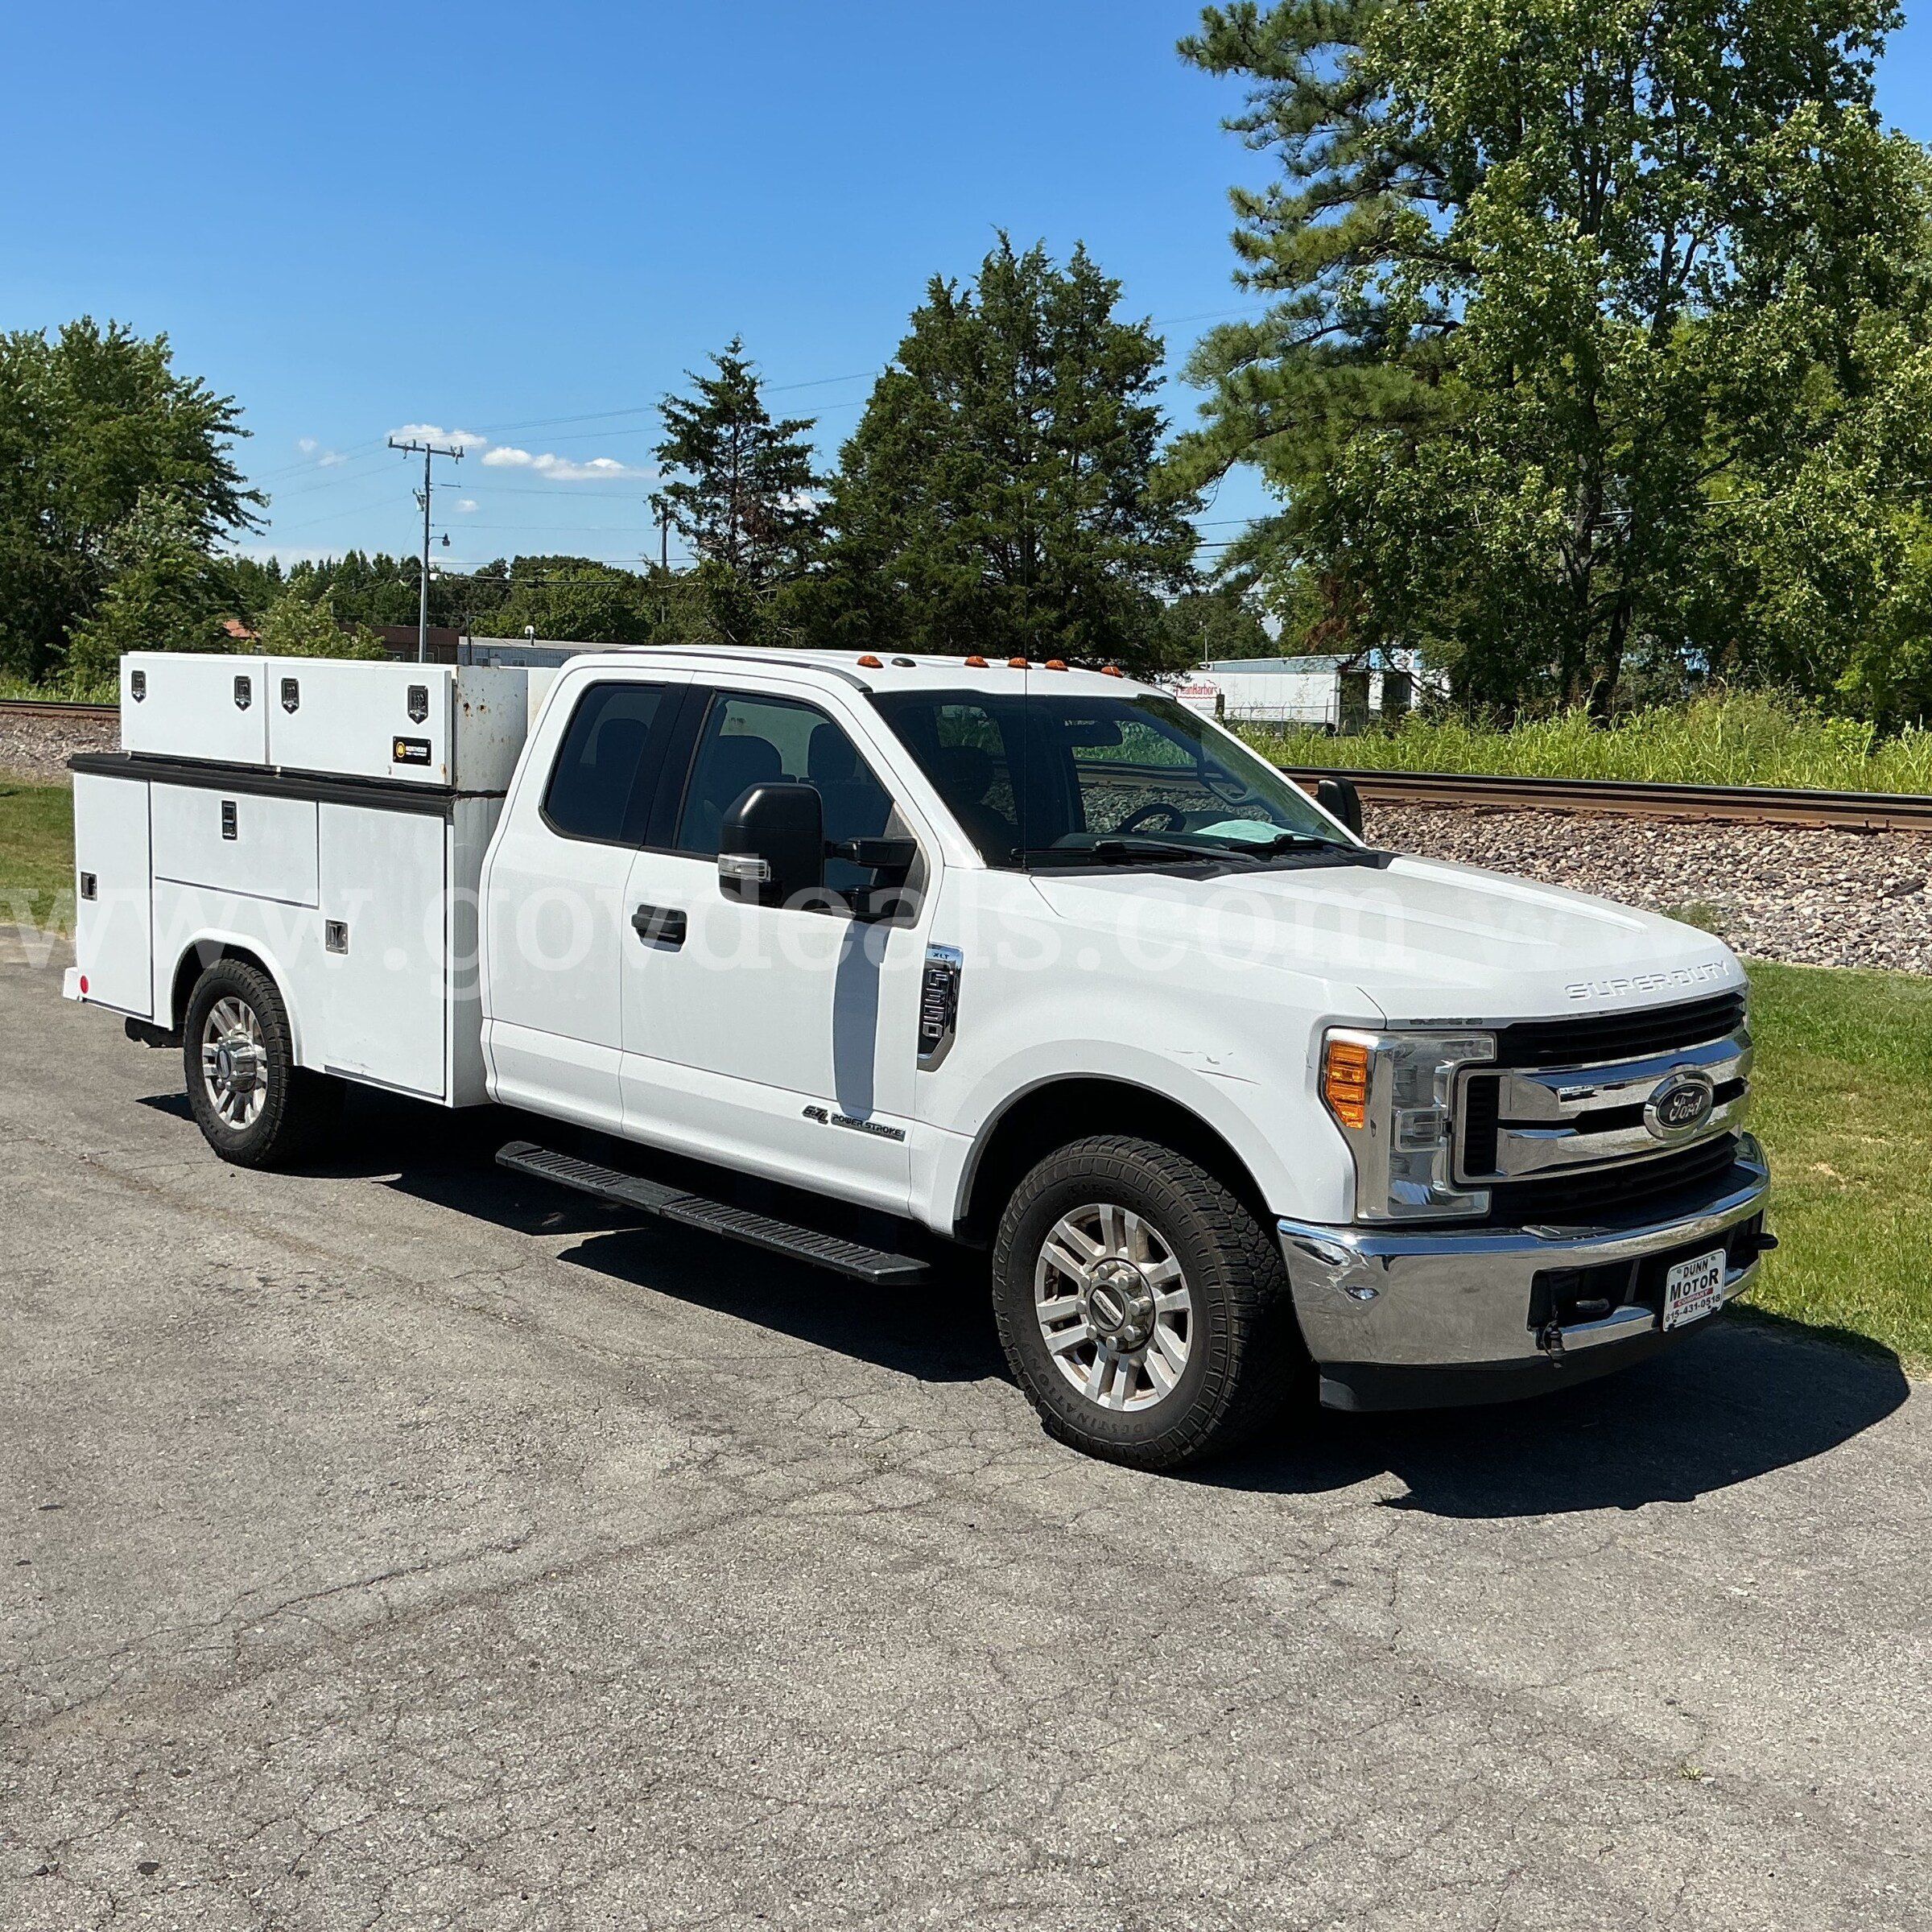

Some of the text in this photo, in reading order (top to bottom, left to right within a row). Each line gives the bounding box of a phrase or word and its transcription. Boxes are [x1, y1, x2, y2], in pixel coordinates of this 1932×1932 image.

[1564, 960, 1730, 1001] SUPER DUTY
[1669, 1090, 1703, 1121] Ford
[832, 1113, 864, 1128] POWER
[865, 1121, 902, 1137] STROKE
[1683, 1258, 1708, 1278] DUNN
[1670, 1267, 1719, 1302] MOTOR
